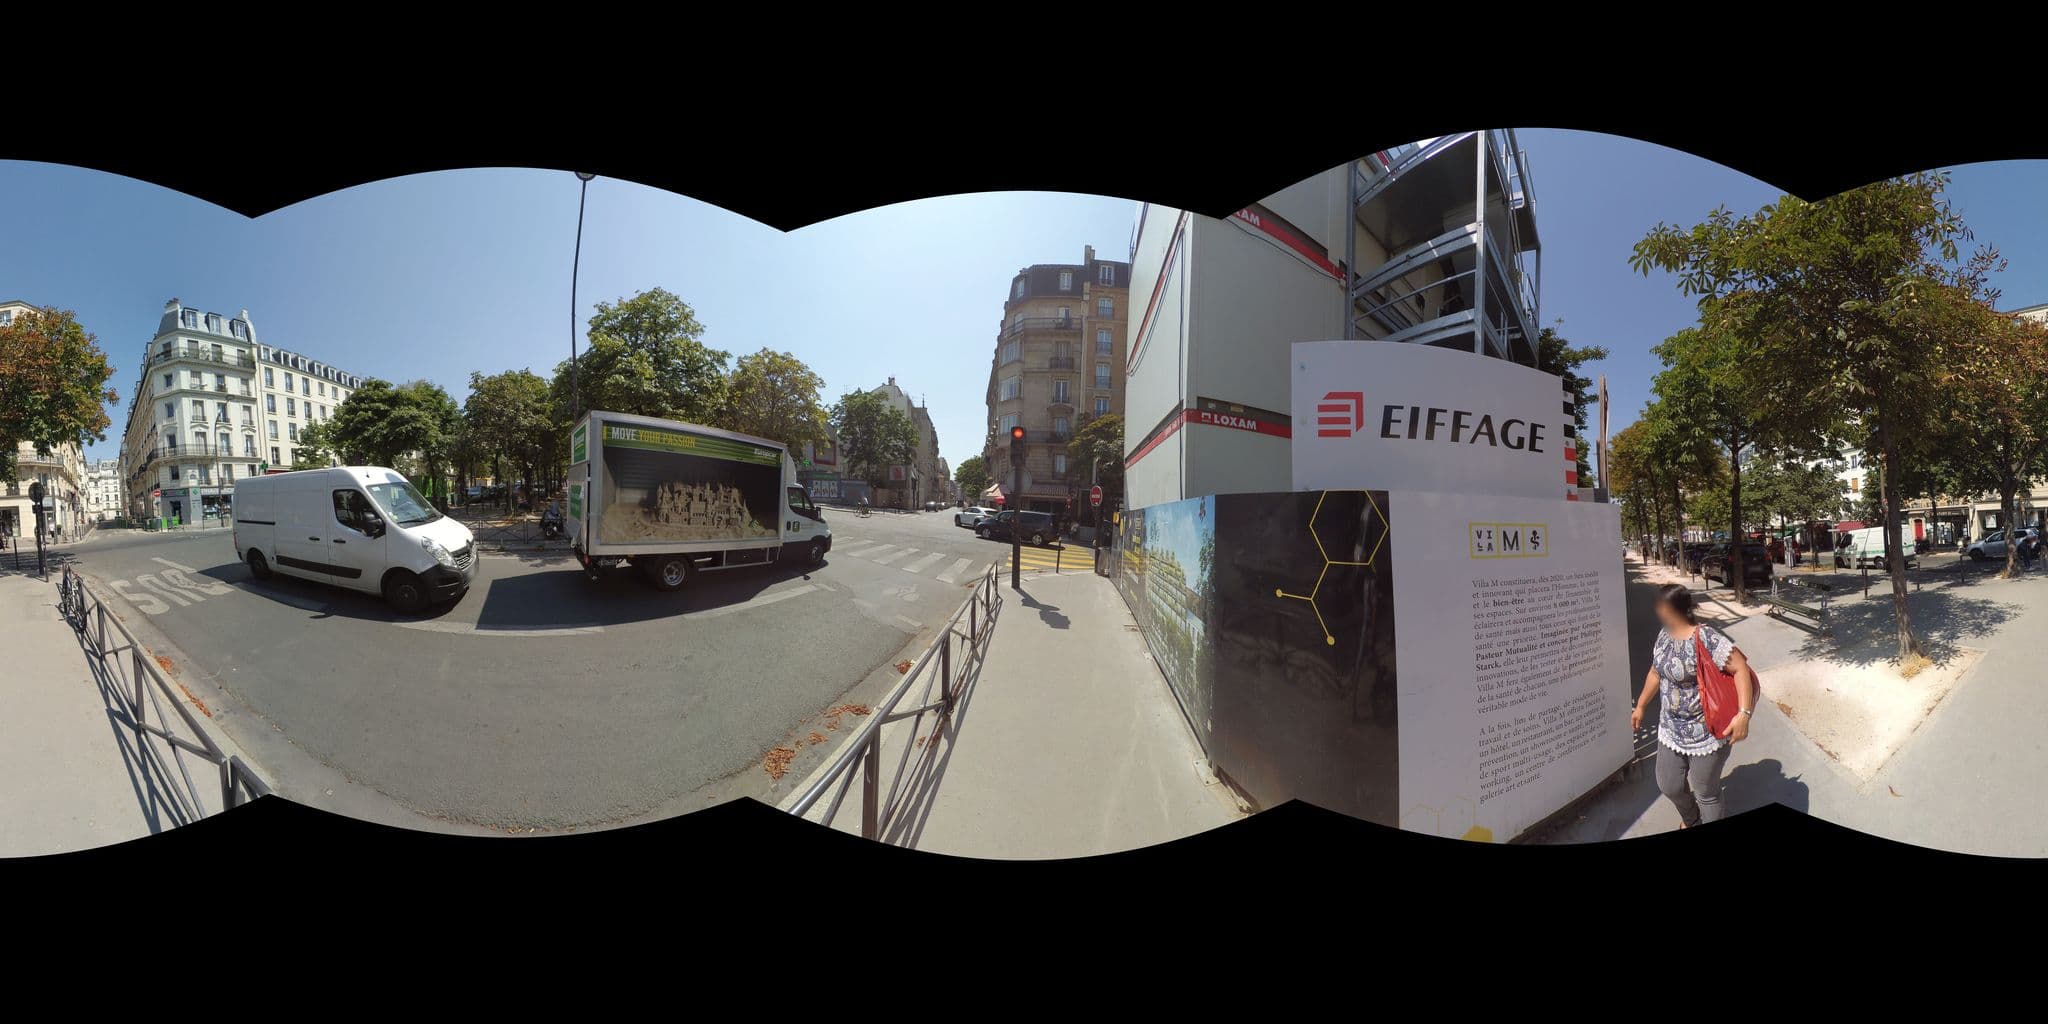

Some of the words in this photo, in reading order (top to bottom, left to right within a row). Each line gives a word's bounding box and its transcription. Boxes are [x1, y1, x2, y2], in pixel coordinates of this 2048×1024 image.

[1236, 208, 1261, 227] AM
[1213, 413, 1257, 431] LOXAM
[1380, 404, 1546, 454] EIFFAGE
[611, 426, 637, 441] MOVE
[639, 429, 661, 444] YOUR
[1472, 580, 1489, 588] Villa
[1491, 579, 1499, 588] M
[1484, 601, 1490, 609] le
[1493, 598, 1525, 607] bien-être
[1516, 607, 1527, 615] Sur
[1475, 632, 1485, 640] de
[1476, 643, 1493, 651] santé
[1476, 652, 1503, 661] Pasteur
[1506, 644, 1538, 656] Mutualité
[1477, 683, 1495, 692] Villa
[1496, 680, 1504, 688] M
[1478, 695, 1487, 704] de
[1488, 693, 1495, 701] la
[1488, 725, 1495, 734] la
[1529, 713, 1537, 721] de
[1513, 729, 1521, 737] de
[1512, 740, 1521, 748] un
[1520, 747, 1529, 755] un
[1480, 771, 1489, 780] de
[1491, 763, 1511, 777] sport
[1515, 770, 1524, 778] un
[1480, 788, 1505, 805] galerie
[1506, 783, 1516, 793] art
